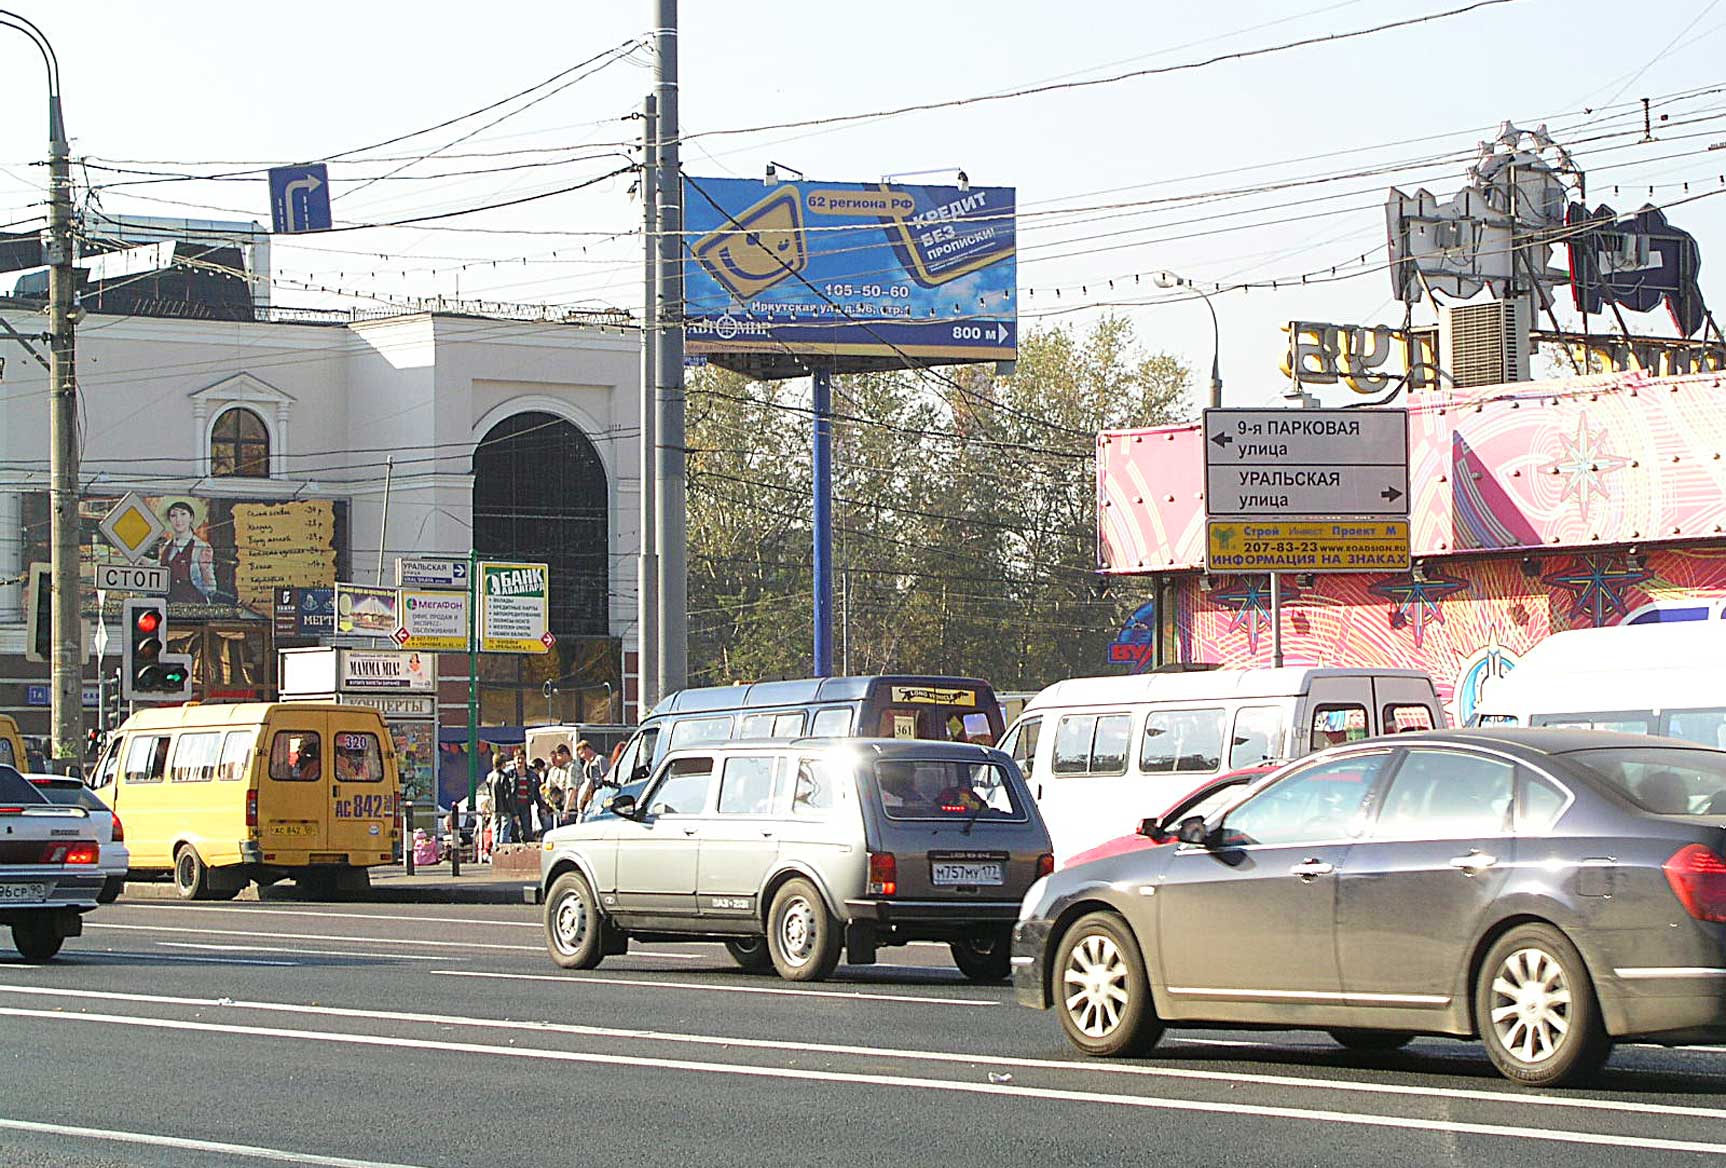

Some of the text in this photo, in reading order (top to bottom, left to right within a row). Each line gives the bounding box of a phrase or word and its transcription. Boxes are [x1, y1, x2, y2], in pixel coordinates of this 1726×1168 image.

[829, 198, 887, 211] региона
[891, 197, 913, 210] РФ
[913, 191, 986, 229] КРЕДИТ
[921, 225, 956, 247] БЕЗ
[927, 227, 995, 259] ПРОПИСКИ!
[825, 284, 909, 298] 105-50-60
[752, 302, 817, 315] Иркутская
[952, 326, 981, 340] 800
[1237, 421, 1360, 435] 9-я ПАРКОВАЯ
[1238, 444, 1287, 458] улица
[1239, 472, 1340, 486] УРАЛЬСКАЯ
[1239, 495, 1288, 509] улица
[1243, 526, 1279, 538] Строй
[1332, 526, 1376, 537] Проект
[1386, 526, 1397, 536] М
[1244, 542, 1318, 552] 207-83-23
[403, 562, 448, 572] УРАЛЬСКАЯ
[1212, 554, 1406, 566] ИНФОРМАЦИЯ НА ЗНАКАХ
[106, 569, 161, 588] СТОП
[500, 568, 544, 587] БАНК
[303, 615, 335, 626] МЕРТ
[349, 661, 400, 676] MAMMA MIA!
[895, 724, 912, 736] 361
[345, 735, 367, 749] 320
[336, 800, 351, 818] АС
[353, 794, 383, 818] 842
